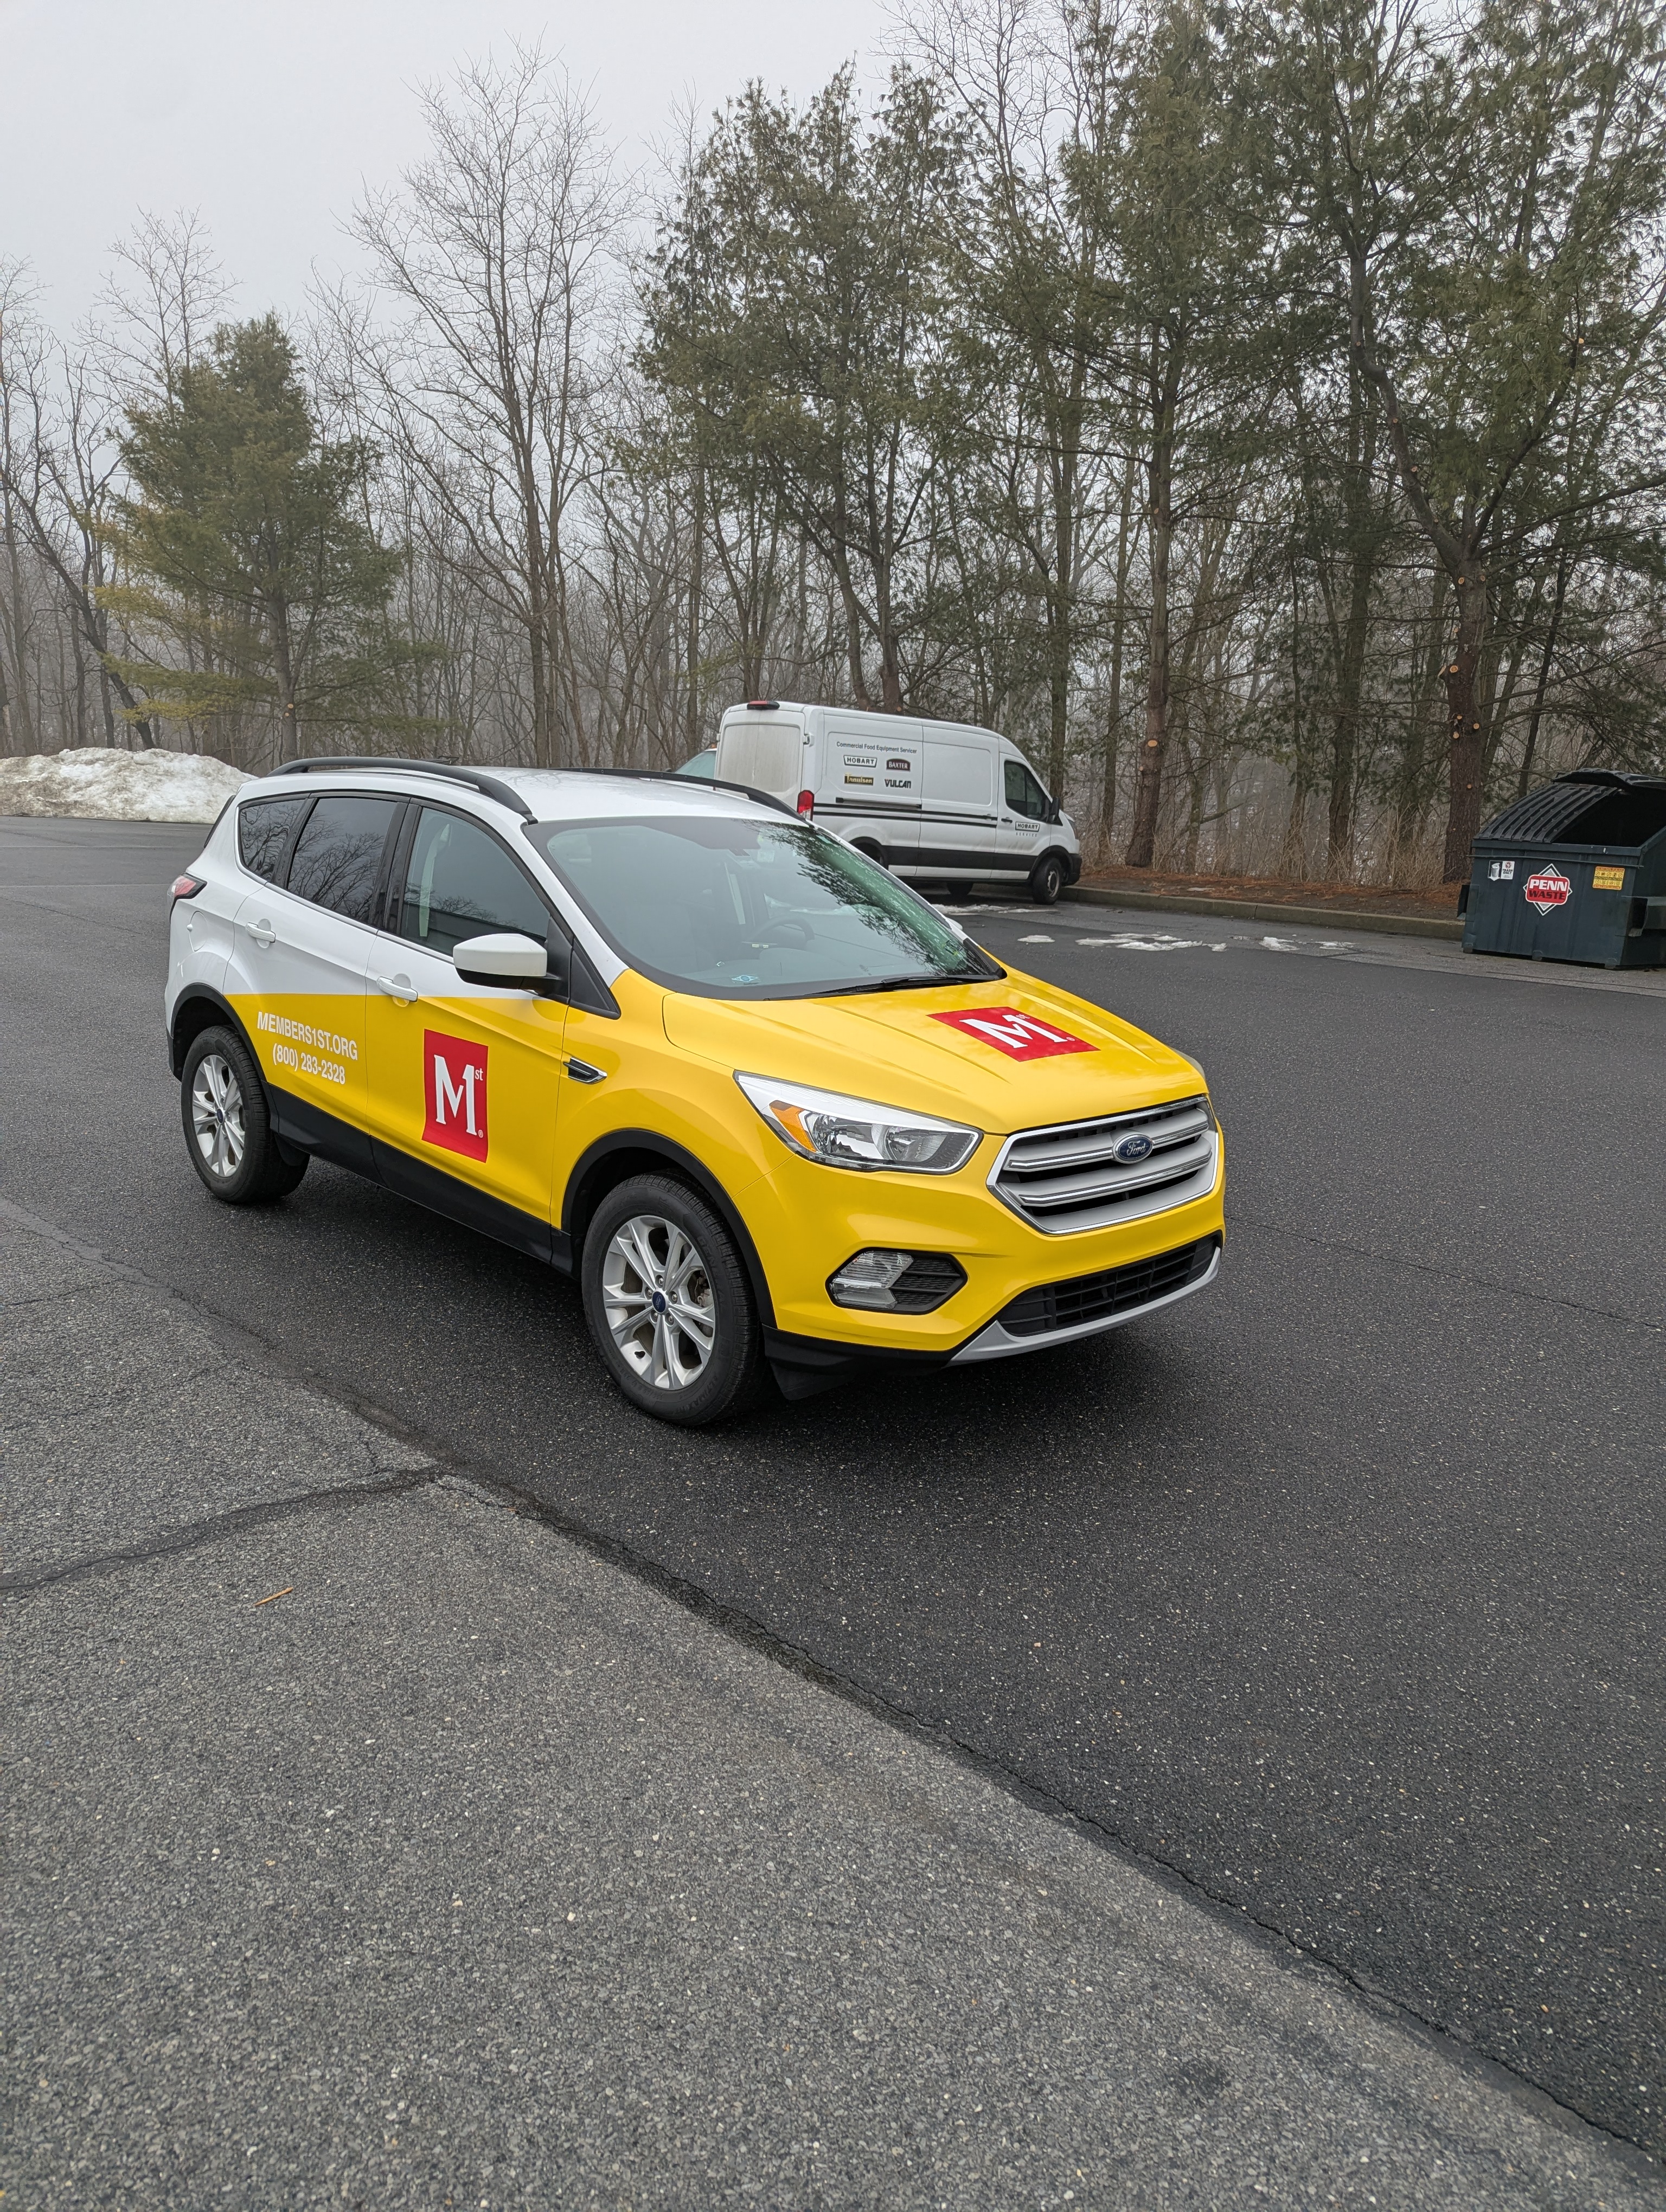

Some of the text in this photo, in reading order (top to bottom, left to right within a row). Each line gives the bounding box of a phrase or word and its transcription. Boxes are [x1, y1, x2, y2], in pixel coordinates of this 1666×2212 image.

[836, 741, 863, 749] Commercial
[847, 757, 875, 765] HOBART
[888, 761, 908, 769] BAXTER
[884, 779, 912, 789] VULCAN
[1529, 879, 1568, 892] PENN
[1529, 890, 1566, 901] WASTE
[257, 1011, 358, 1061] MEMBERS1ST.ORG
[272, 1043, 346, 1085] (800) 283-2328
[1126, 1140, 1149, 1156] Ford
